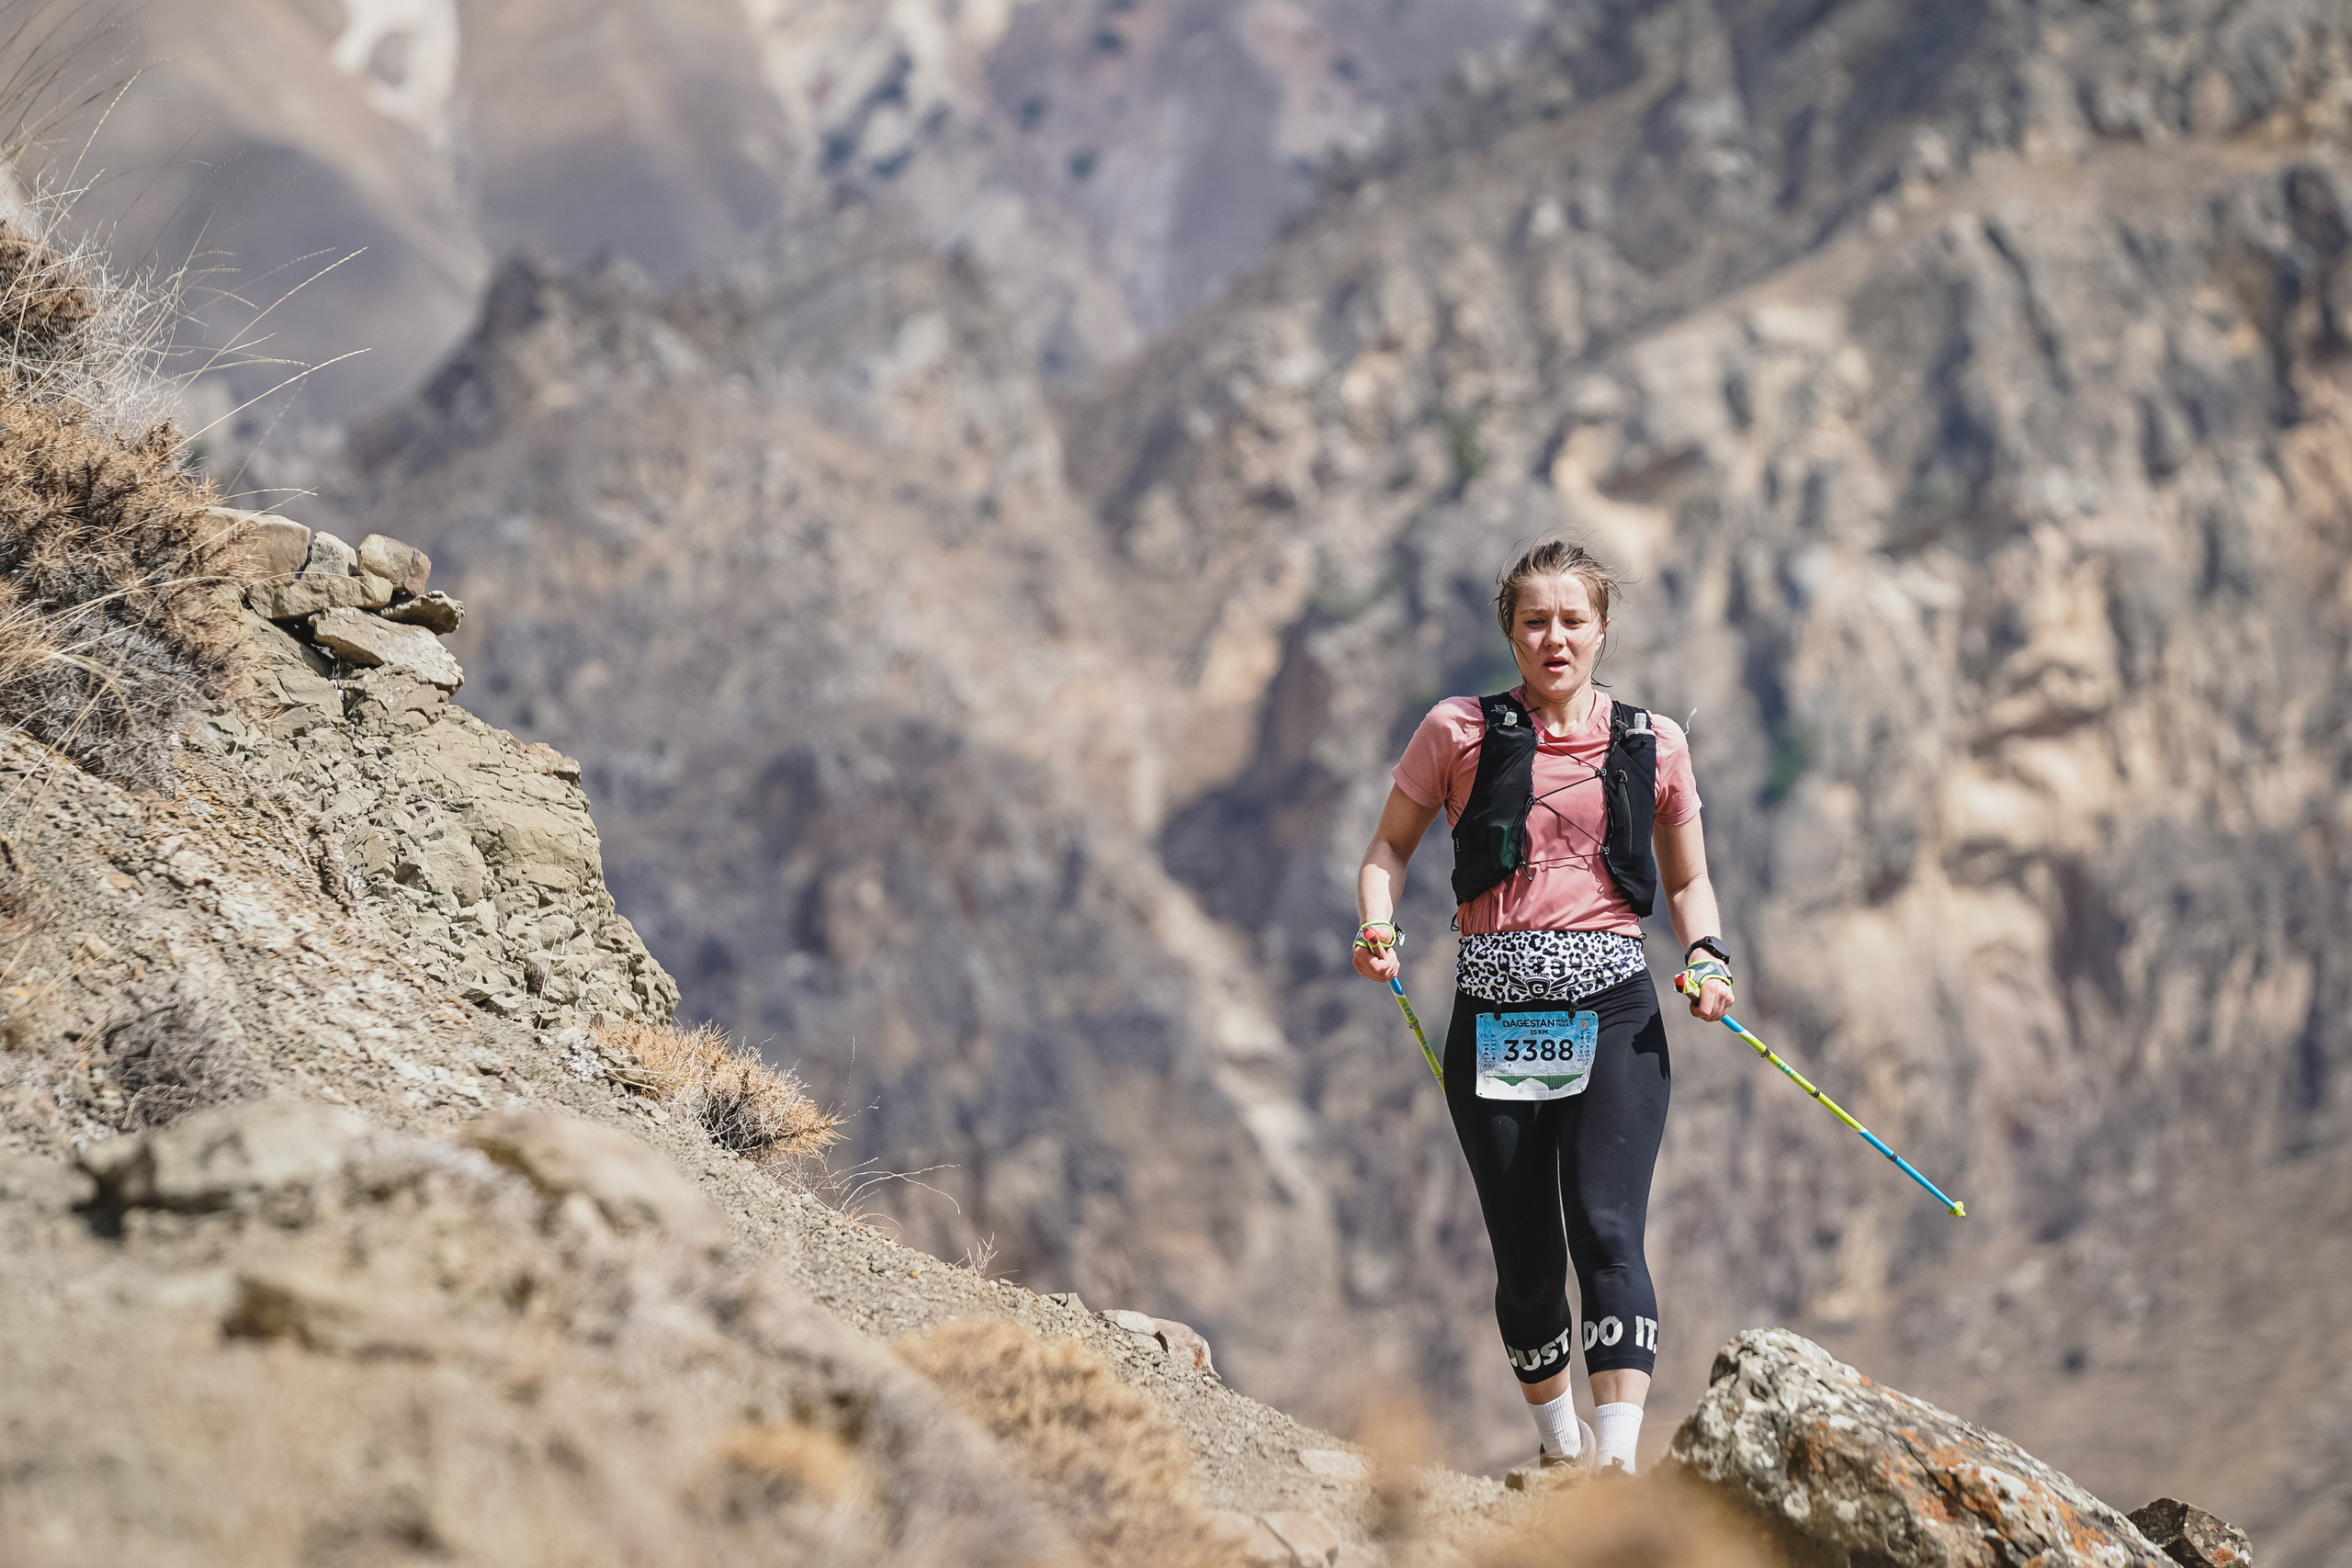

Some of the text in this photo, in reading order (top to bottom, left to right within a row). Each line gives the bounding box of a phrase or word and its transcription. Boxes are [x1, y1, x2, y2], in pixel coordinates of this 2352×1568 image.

[1532, 984, 1544, 994] G
[1502, 1018, 1555, 1028] DAGESTAN
[1503, 1039, 1574, 1062] 3388
[1507, 1327, 1569, 1371] JUST
[1583, 1315, 1623, 1351] DO
